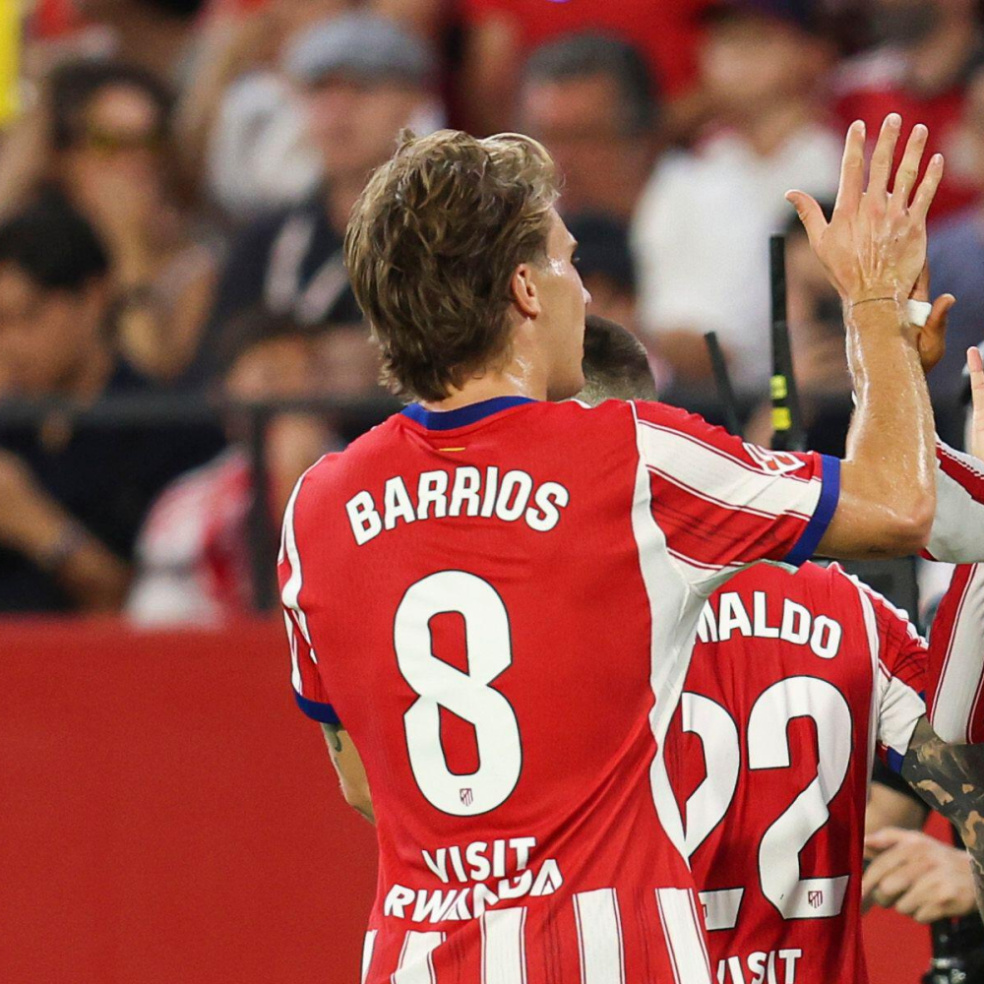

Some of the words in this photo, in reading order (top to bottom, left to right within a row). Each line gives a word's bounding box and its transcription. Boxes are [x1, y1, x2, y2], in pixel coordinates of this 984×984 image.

[345, 466, 569, 546] BARRIOS
[697, 590, 842, 659] MALDO
[394, 569, 523, 816] 8
[384, 858, 564, 924] RWANDA
[422, 836, 536, 884] VISIT
